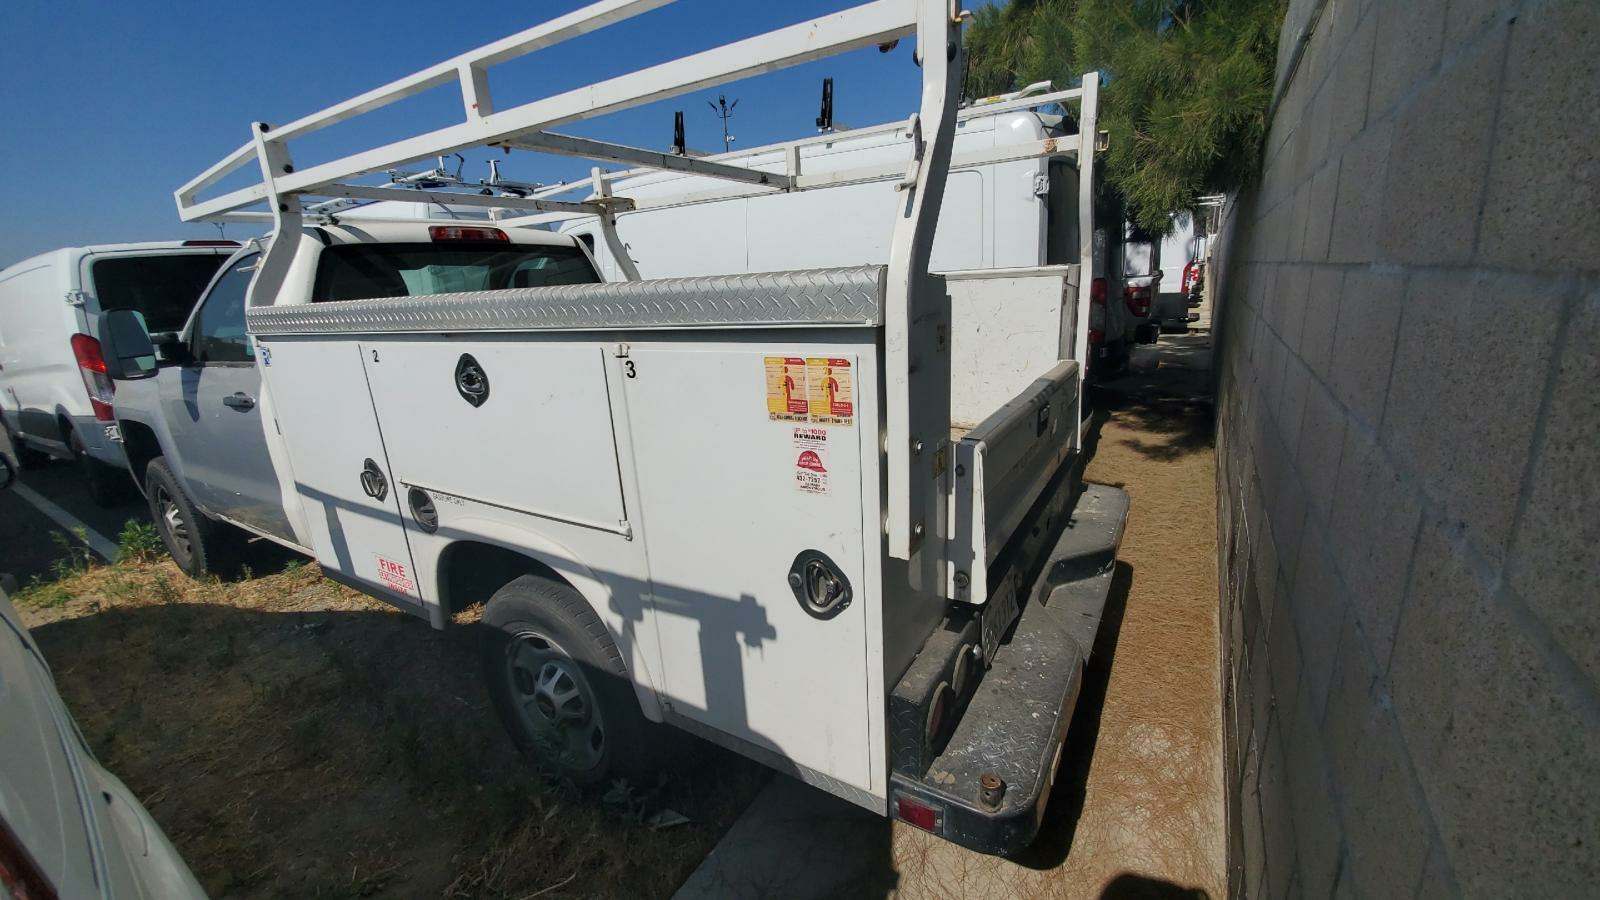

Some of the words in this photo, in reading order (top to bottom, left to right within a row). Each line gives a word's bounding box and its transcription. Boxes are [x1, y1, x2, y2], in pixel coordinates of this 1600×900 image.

[372, 349, 380, 363] 2
[625, 360, 636, 379] 3
[793, 433, 827, 441] REWARD
[379, 558, 405, 577] FIRE
